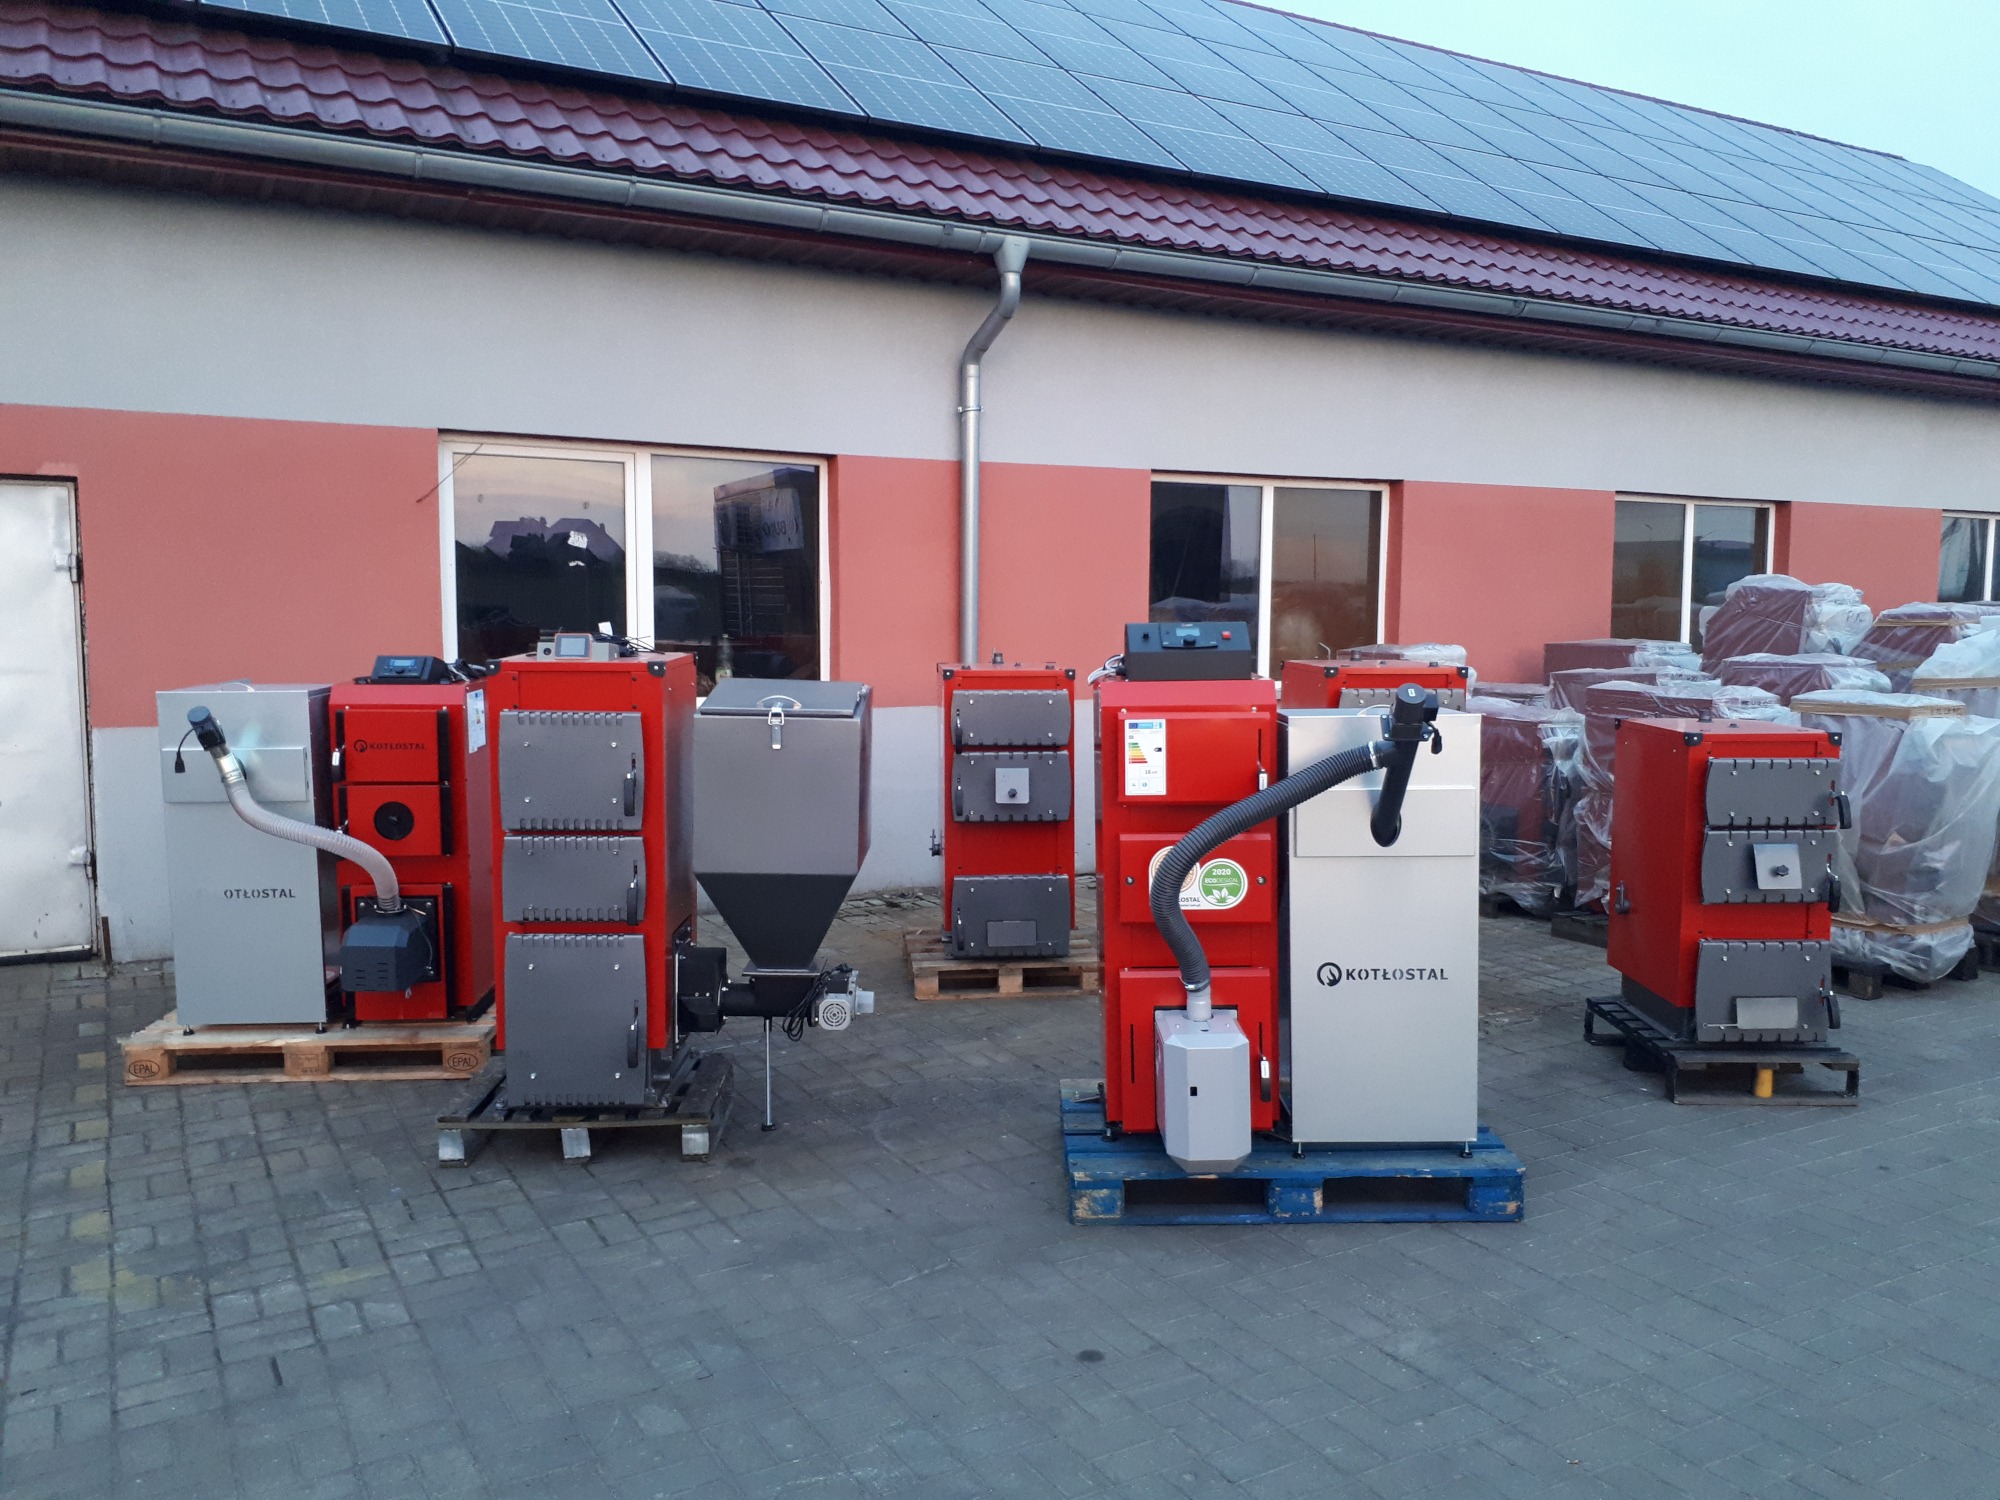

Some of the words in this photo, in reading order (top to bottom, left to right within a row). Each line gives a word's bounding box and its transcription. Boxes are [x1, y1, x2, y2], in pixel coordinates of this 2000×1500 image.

[1212, 868, 1231, 876] 2020
[1345, 968, 1449, 981] KOTŁOSTAL
[452, 1057, 473, 1067] EPAL
[133, 1064, 156, 1075] EPAL
